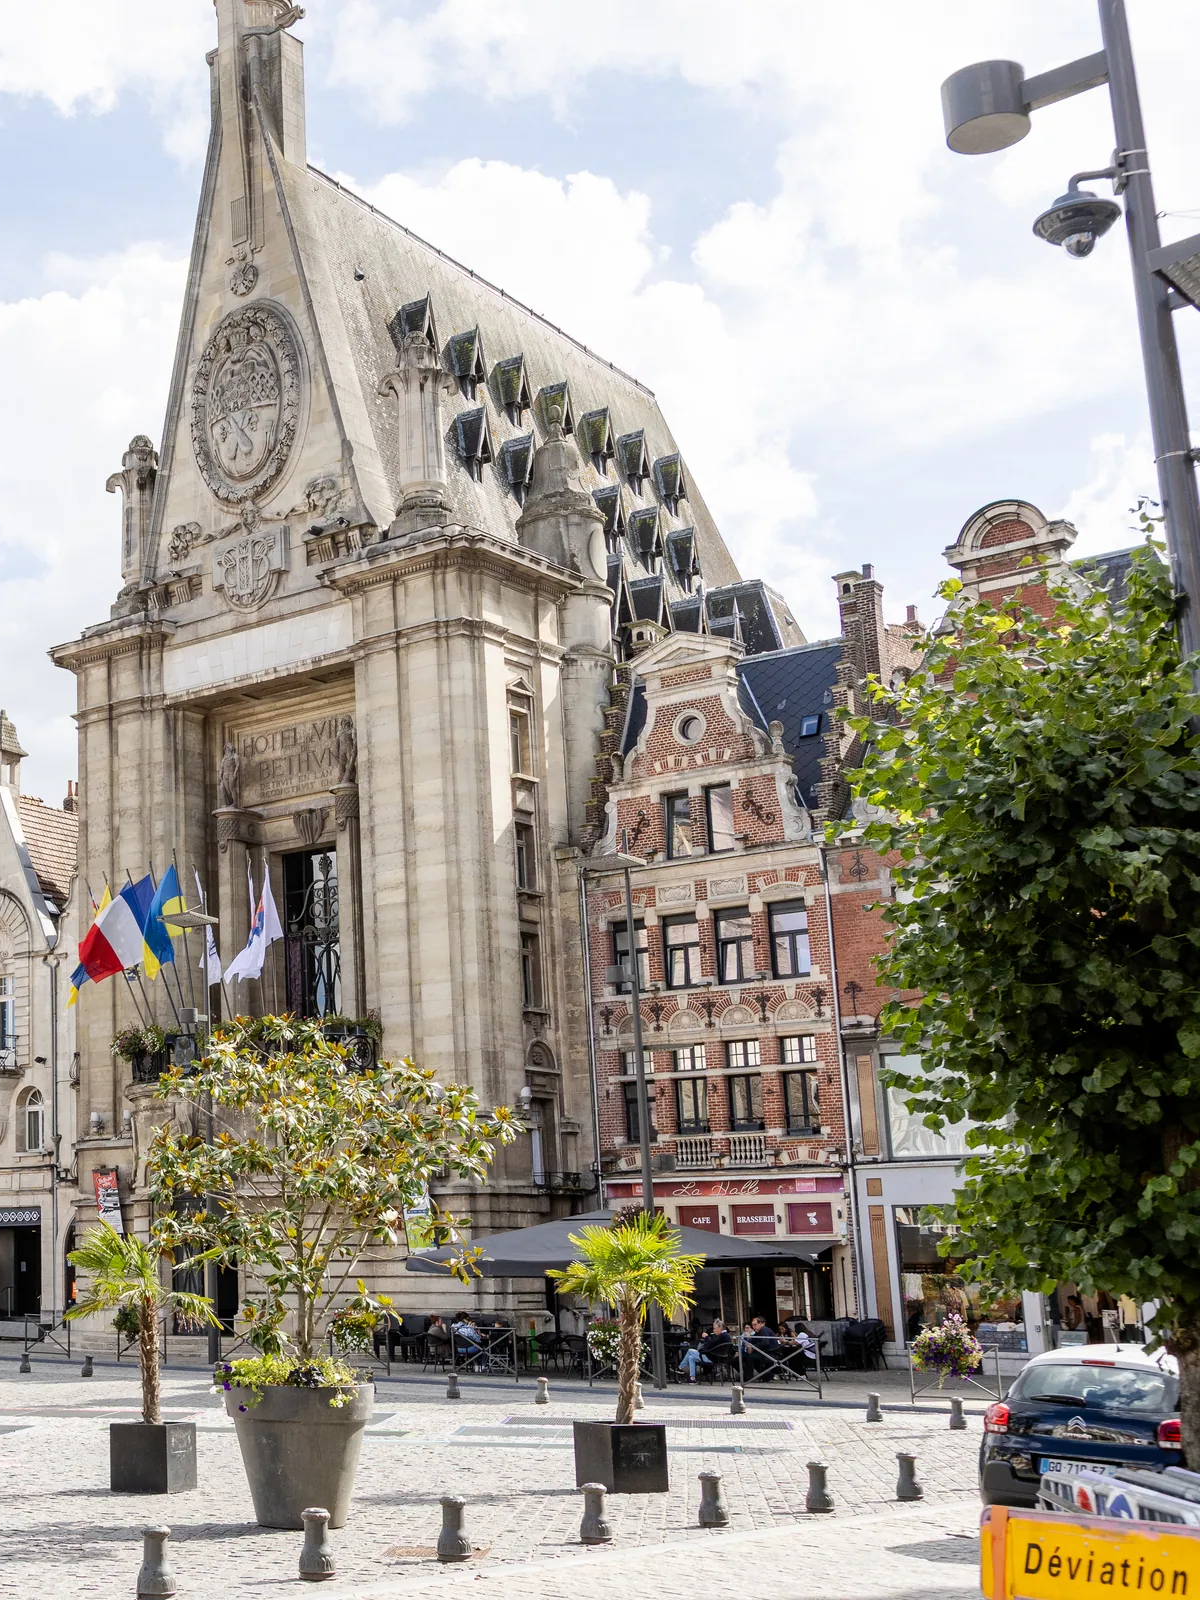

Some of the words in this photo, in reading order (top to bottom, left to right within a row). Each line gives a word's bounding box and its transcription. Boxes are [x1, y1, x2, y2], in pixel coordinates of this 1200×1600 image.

[243, 727, 298, 757] HOTEL
[259, 747, 340, 781] BETHVN
[672, 1181, 702, 1196] La
[711, 1179, 762, 1196] Halle
[736, 1215, 776, 1224] BRASSERIE
[1024, 1542, 1189, 1596] Déviation
